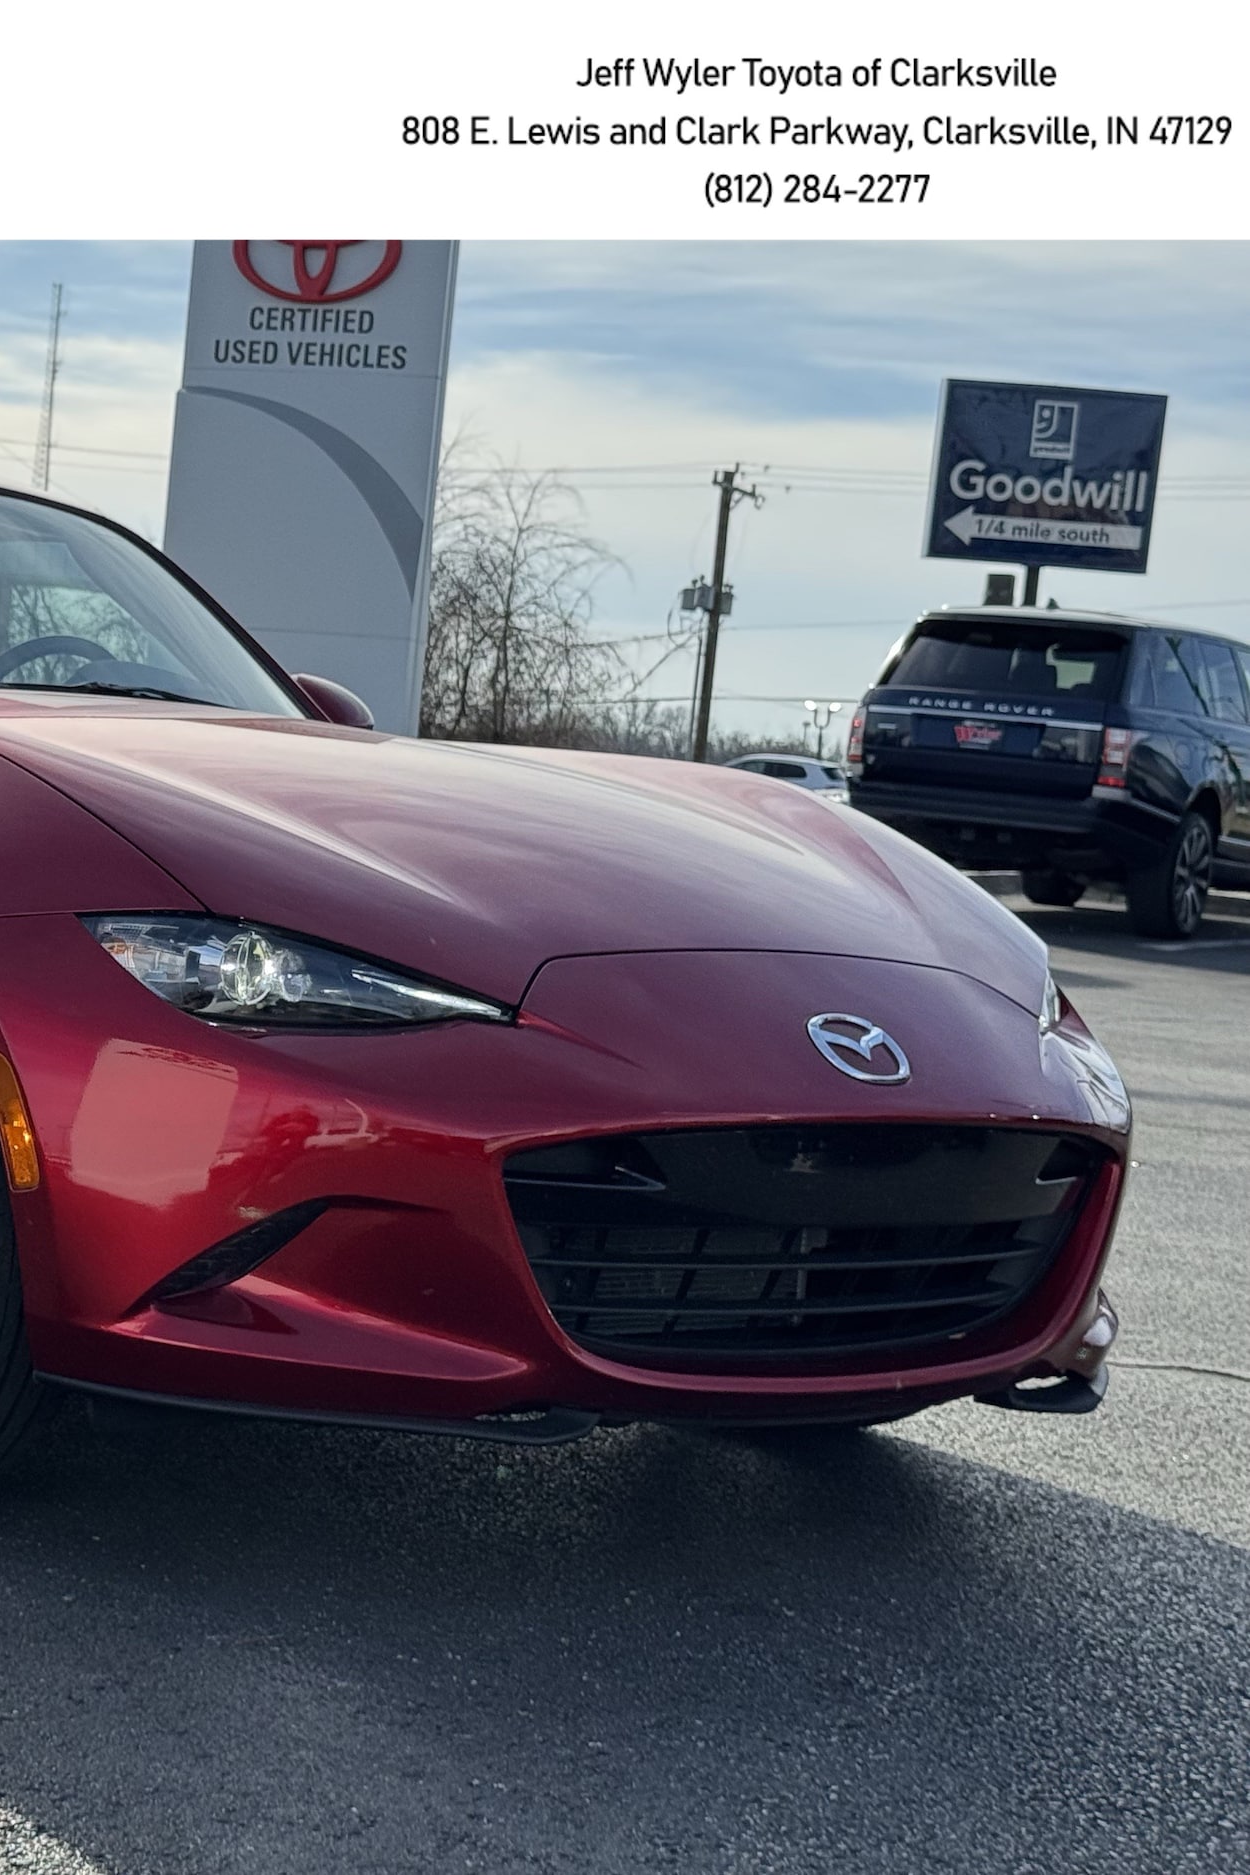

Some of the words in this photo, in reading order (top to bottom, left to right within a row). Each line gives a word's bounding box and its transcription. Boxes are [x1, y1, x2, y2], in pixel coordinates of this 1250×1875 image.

[249, 306, 375, 335] CERTIFIED
[213, 339, 279, 365] USED
[287, 341, 408, 370] VEHICLES
[950, 458, 1148, 513] Goodwill
[975, 518, 1006, 534] 1/4
[1011, 521, 1050, 538] mile
[1057, 526, 1111, 544] south
[909, 696, 973, 710] RANGE
[983, 702, 1055, 717] ROVER
